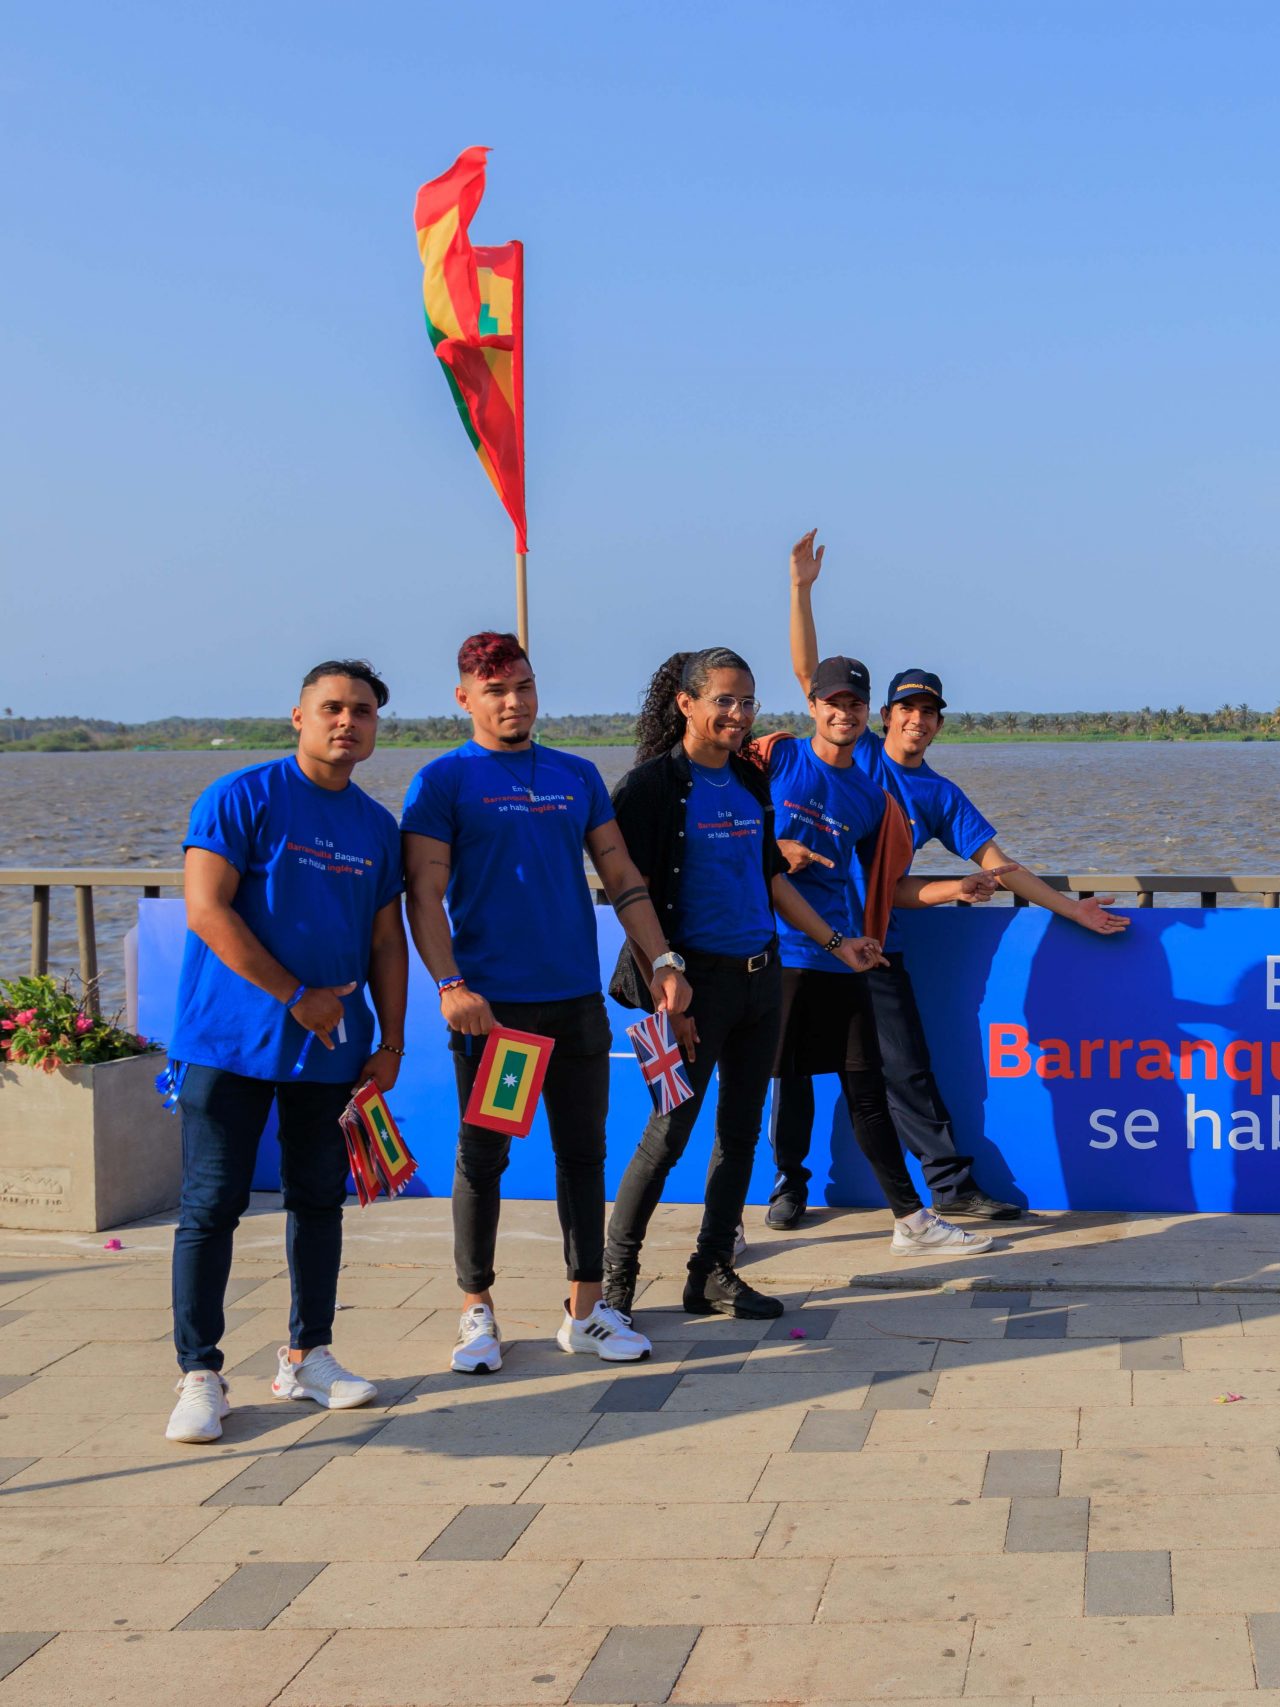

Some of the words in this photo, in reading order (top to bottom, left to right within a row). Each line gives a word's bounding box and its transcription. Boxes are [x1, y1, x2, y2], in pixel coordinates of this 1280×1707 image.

[510, 804, 529, 813] habla
[315, 837, 324, 846] En
[326, 840, 334, 848] la
[335, 852, 364, 864] Baqana
[1090, 1108, 1159, 1151] se
